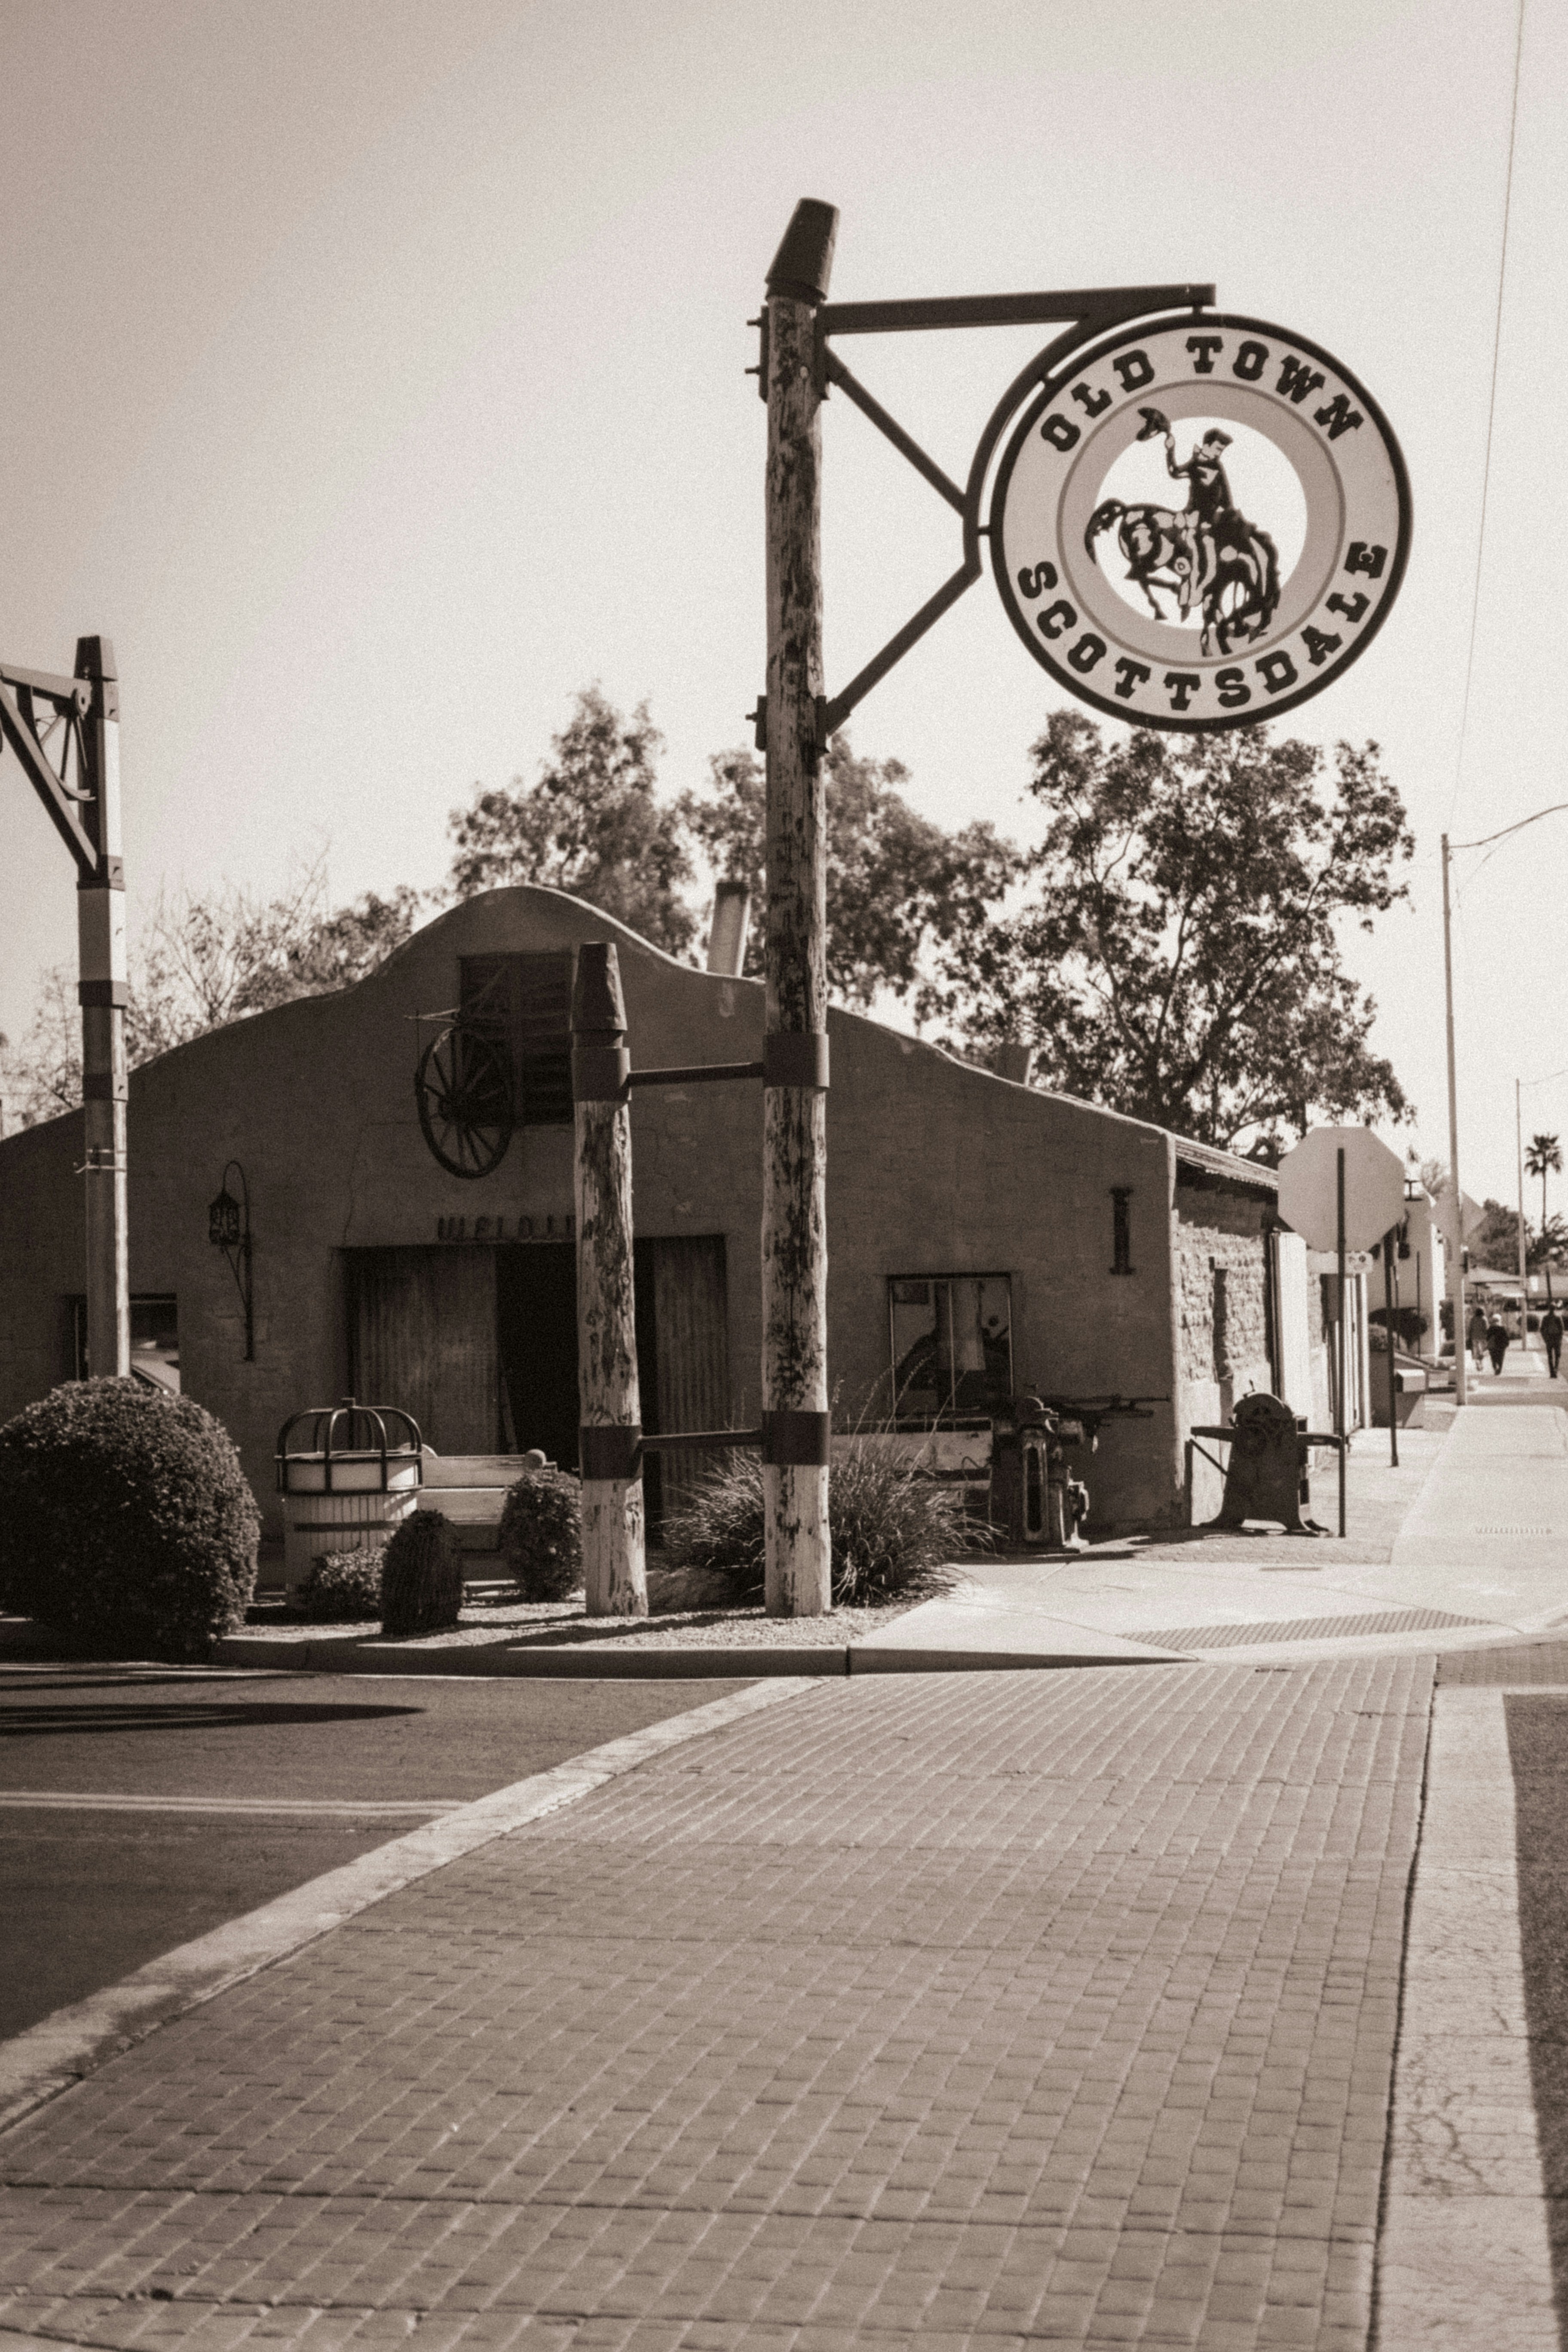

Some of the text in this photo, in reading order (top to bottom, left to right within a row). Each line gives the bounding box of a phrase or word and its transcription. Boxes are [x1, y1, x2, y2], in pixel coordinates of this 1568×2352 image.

[1041, 336, 1364, 452] OLD TOWN
[1017, 541, 1388, 711] SCOTTSDALE
